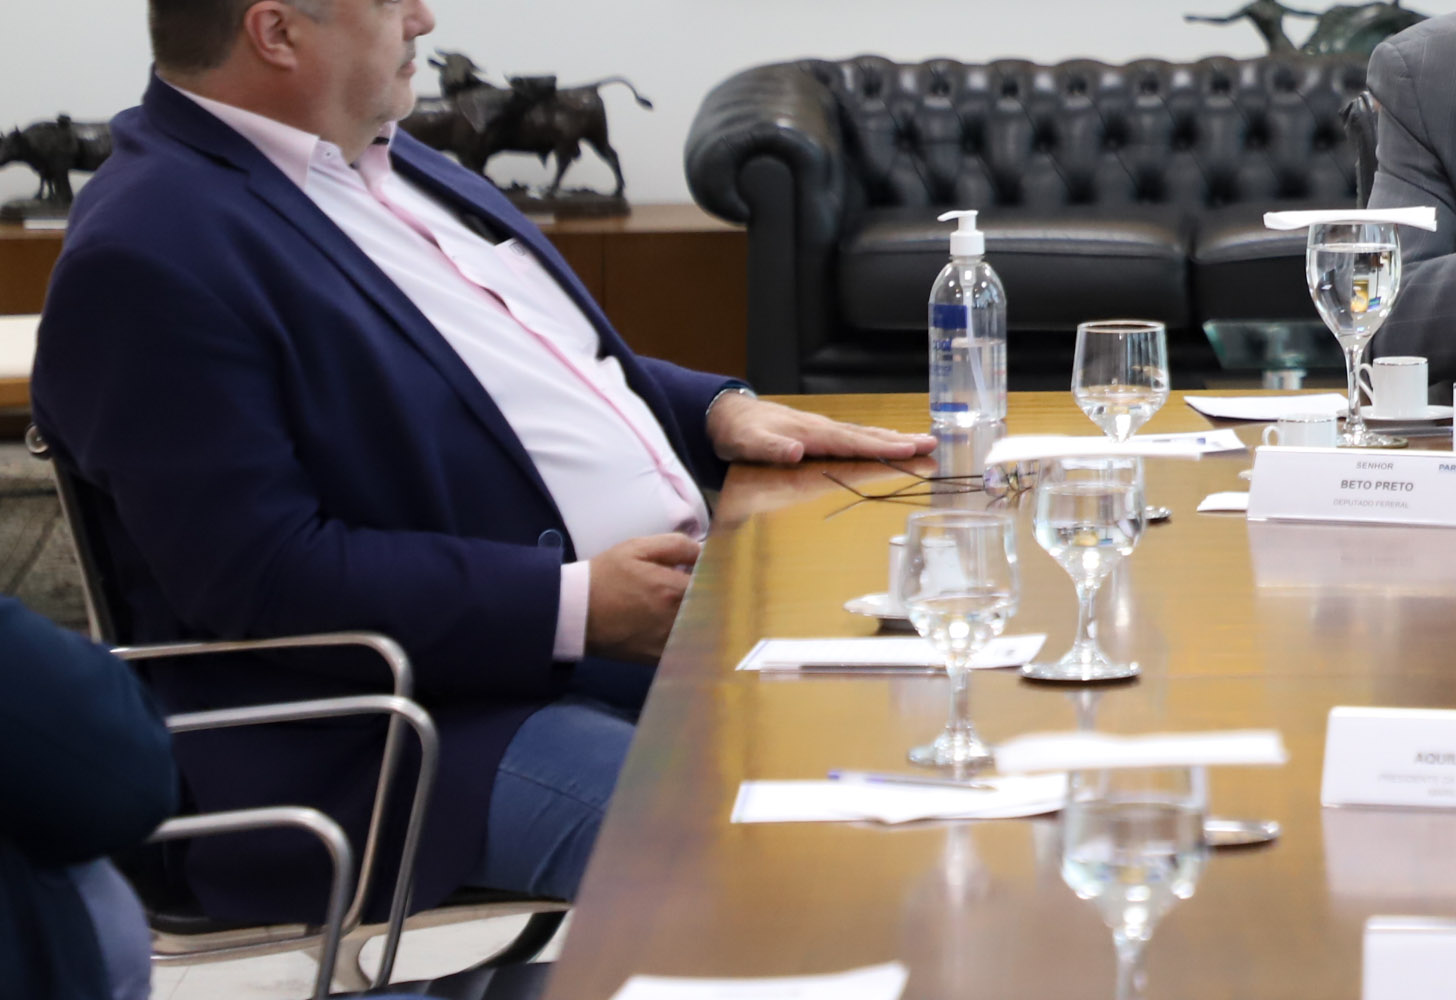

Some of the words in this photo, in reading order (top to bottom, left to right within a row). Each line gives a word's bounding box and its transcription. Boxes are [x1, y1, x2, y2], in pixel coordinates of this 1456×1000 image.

[1355, 461, 1394, 470] SENHOR
[1340, 479, 1372, 490] BETO
[1375, 481, 1414, 492] PRETO
[1333, 498, 1374, 507] DEPUTADO
